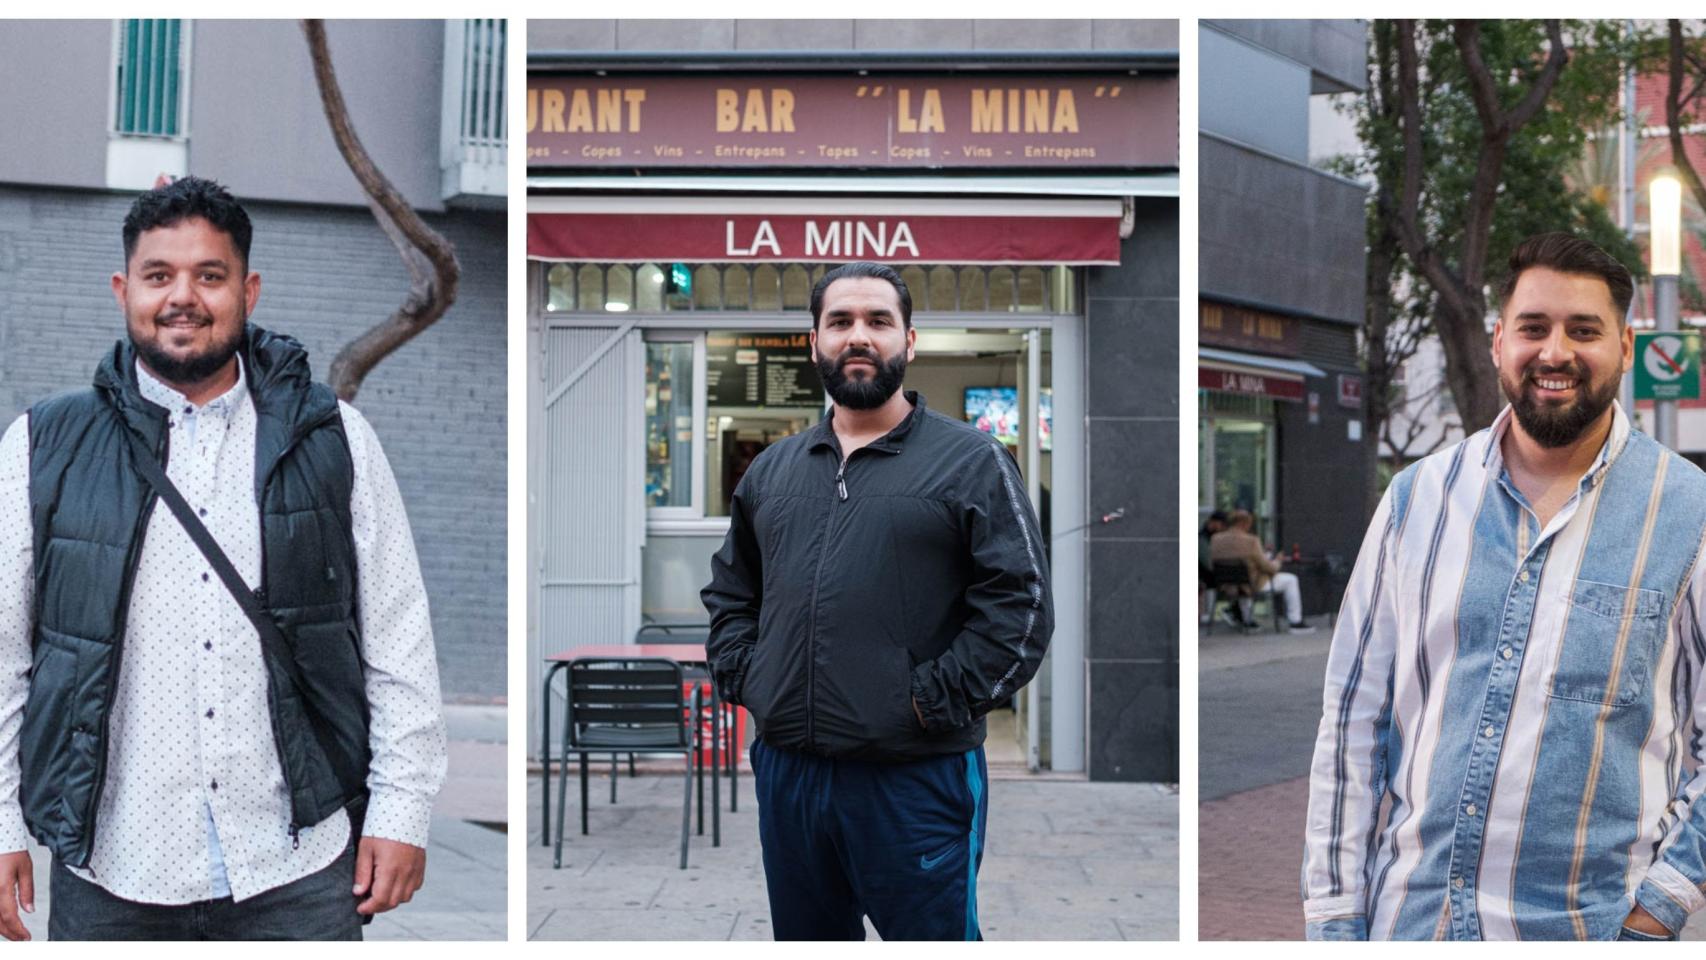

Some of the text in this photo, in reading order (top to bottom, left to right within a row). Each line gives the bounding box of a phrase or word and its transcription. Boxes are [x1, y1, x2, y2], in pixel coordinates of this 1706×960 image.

[715, 88, 796, 132] BAR
[897, 88, 946, 133] LA
[970, 88, 1079, 133] MINA
[581, 144, 622, 160] Copes
[653, 145, 683, 157] Vins
[714, 145, 785, 160] Entrepans
[817, 145, 859, 160] Tapes
[890, 145, 931, 159] Copes
[962, 146, 993, 157] Vins
[1024, 146, 1096, 160] Entrepans
[725, 220, 921, 257] LA MINA
[1222, 373, 1266, 393] LA MINA
